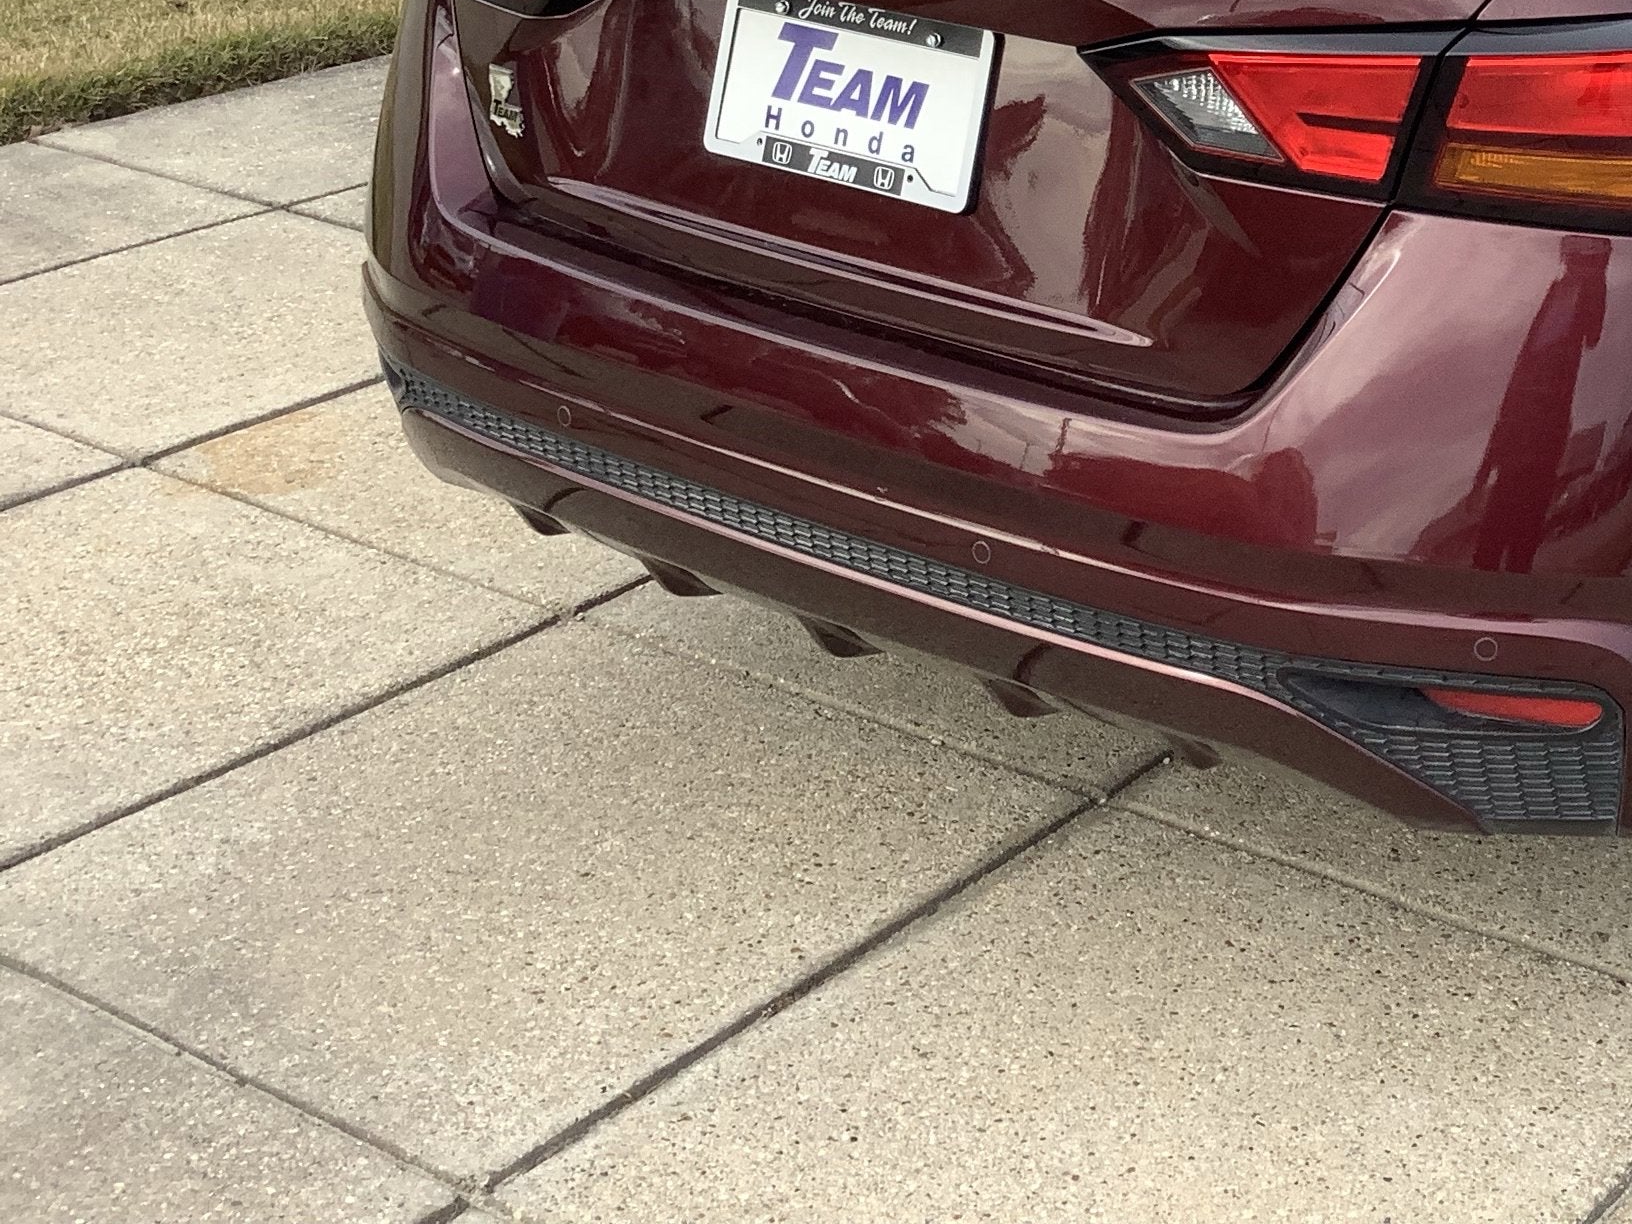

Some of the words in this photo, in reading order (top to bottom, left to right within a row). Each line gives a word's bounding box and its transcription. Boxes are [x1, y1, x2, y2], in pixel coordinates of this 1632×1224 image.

[838, 1, 866, 24] The
[868, 7, 918, 36] Team!
[771, 22, 930, 130] TEAM
[764, 105, 915, 164] Honda
[807, 147, 858, 184] TEAM
